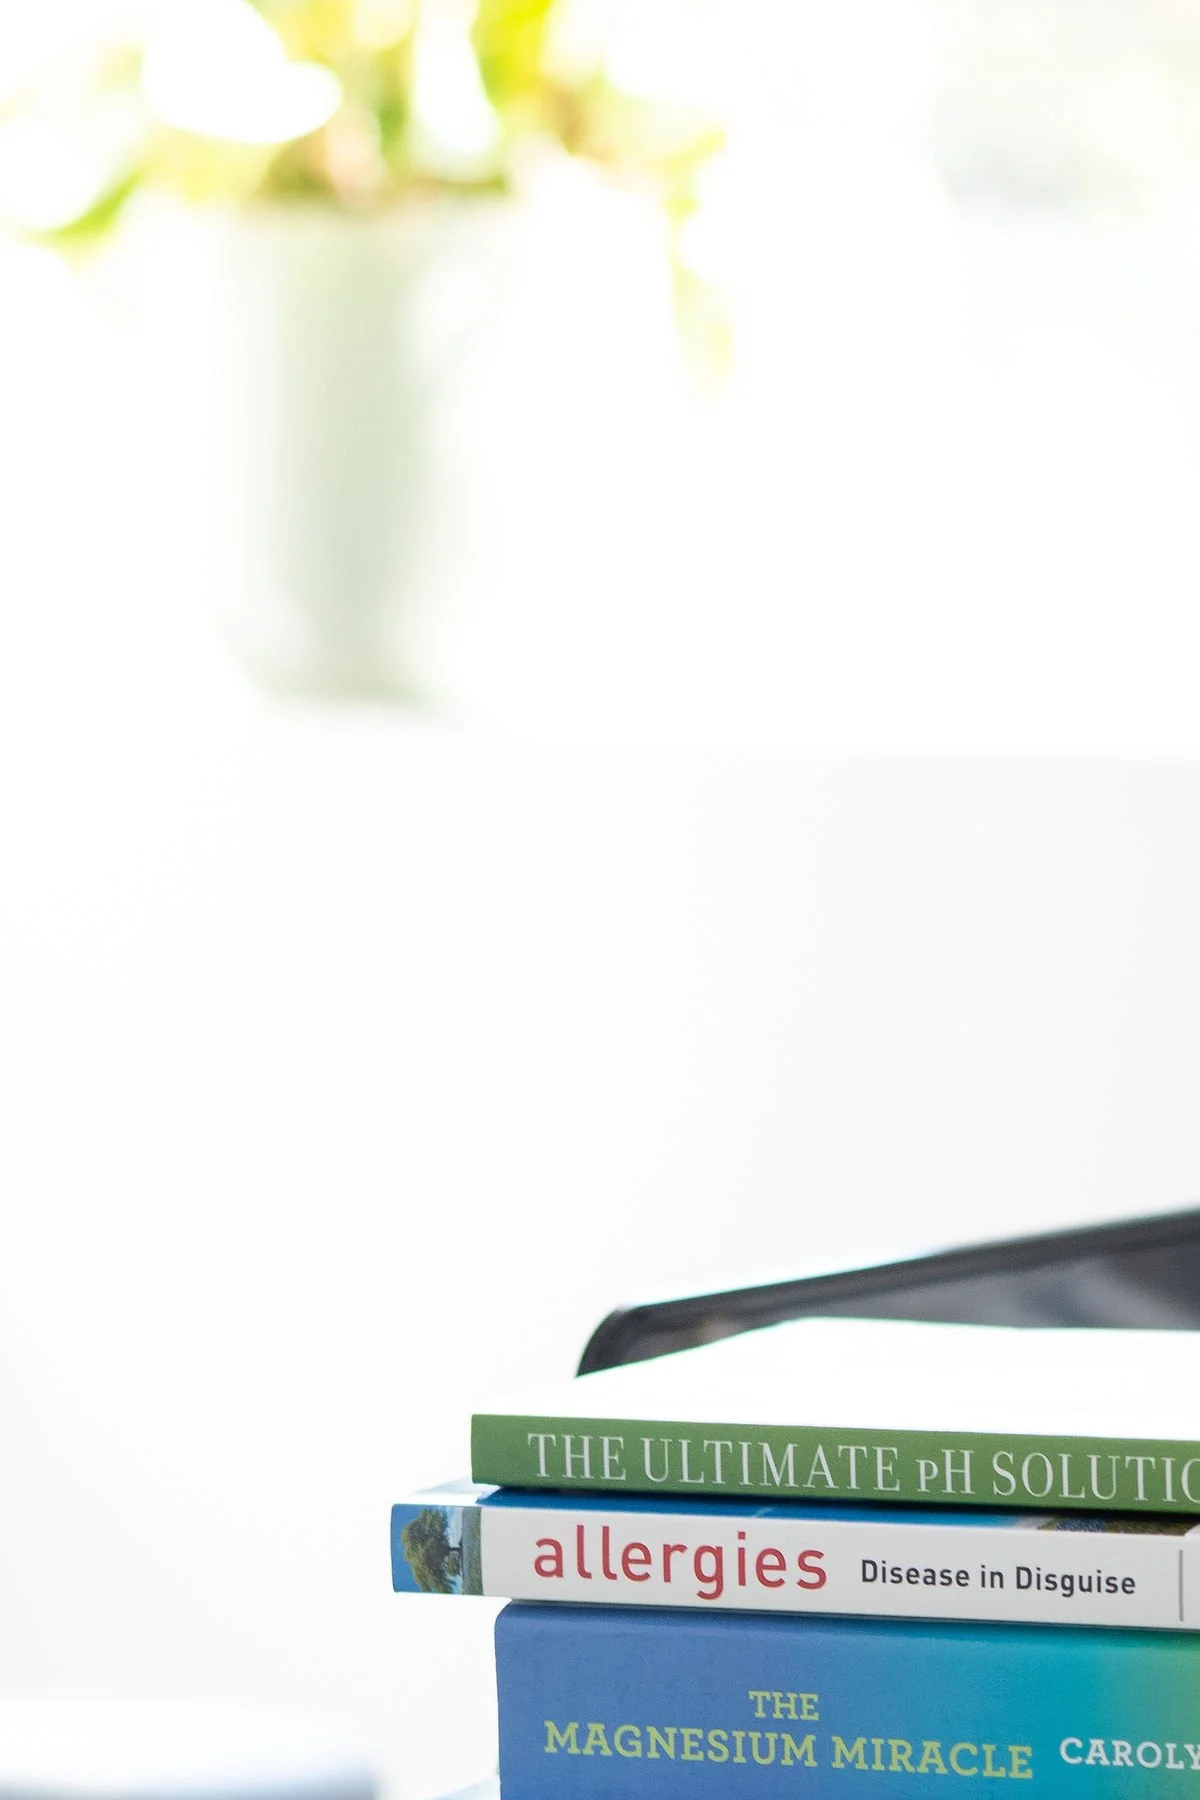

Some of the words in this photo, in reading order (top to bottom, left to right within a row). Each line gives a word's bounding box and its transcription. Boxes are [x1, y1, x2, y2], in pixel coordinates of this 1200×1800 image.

[527, 1433, 628, 1482] THE
[643, 1439, 901, 1492] ULTIMATE
[917, 1449, 973, 1496] pH
[534, 1524, 828, 1600] allergies
[860, 1560, 969, 1588] Disease
[979, 1565, 1005, 1590] in
[1016, 1567, 1137, 1598] Disguise
[749, 1690, 819, 1721] THE
[544, 1721, 816, 1767] MAGNESIUM
[831, 1737, 1033, 1779] MIRACLE
